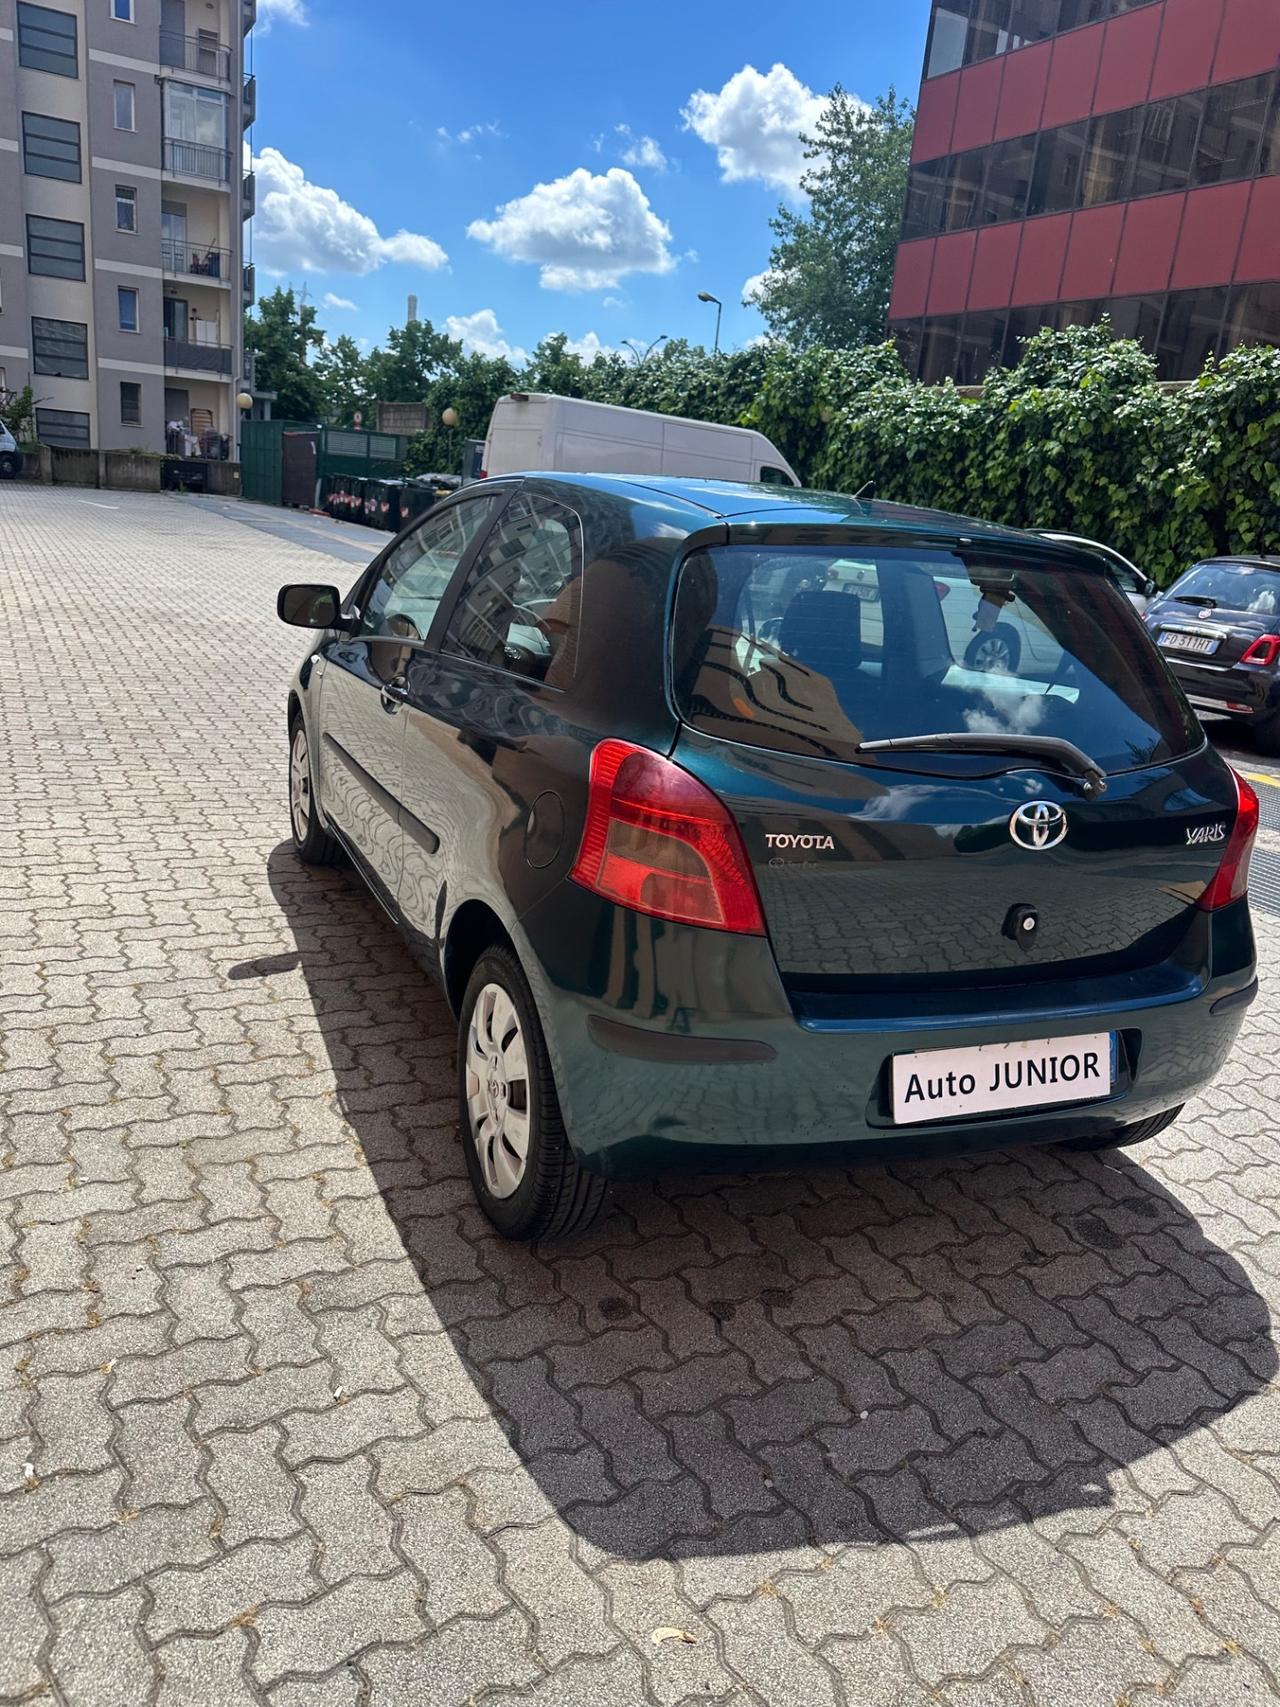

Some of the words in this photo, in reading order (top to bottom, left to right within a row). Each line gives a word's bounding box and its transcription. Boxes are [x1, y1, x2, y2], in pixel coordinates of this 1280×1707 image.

[765, 833, 835, 850] TOYOTA
[1186, 823, 1226, 845] YARIS
[904, 1071, 976, 1103] Auto
[989, 1052, 1101, 1091] JUNIOR
